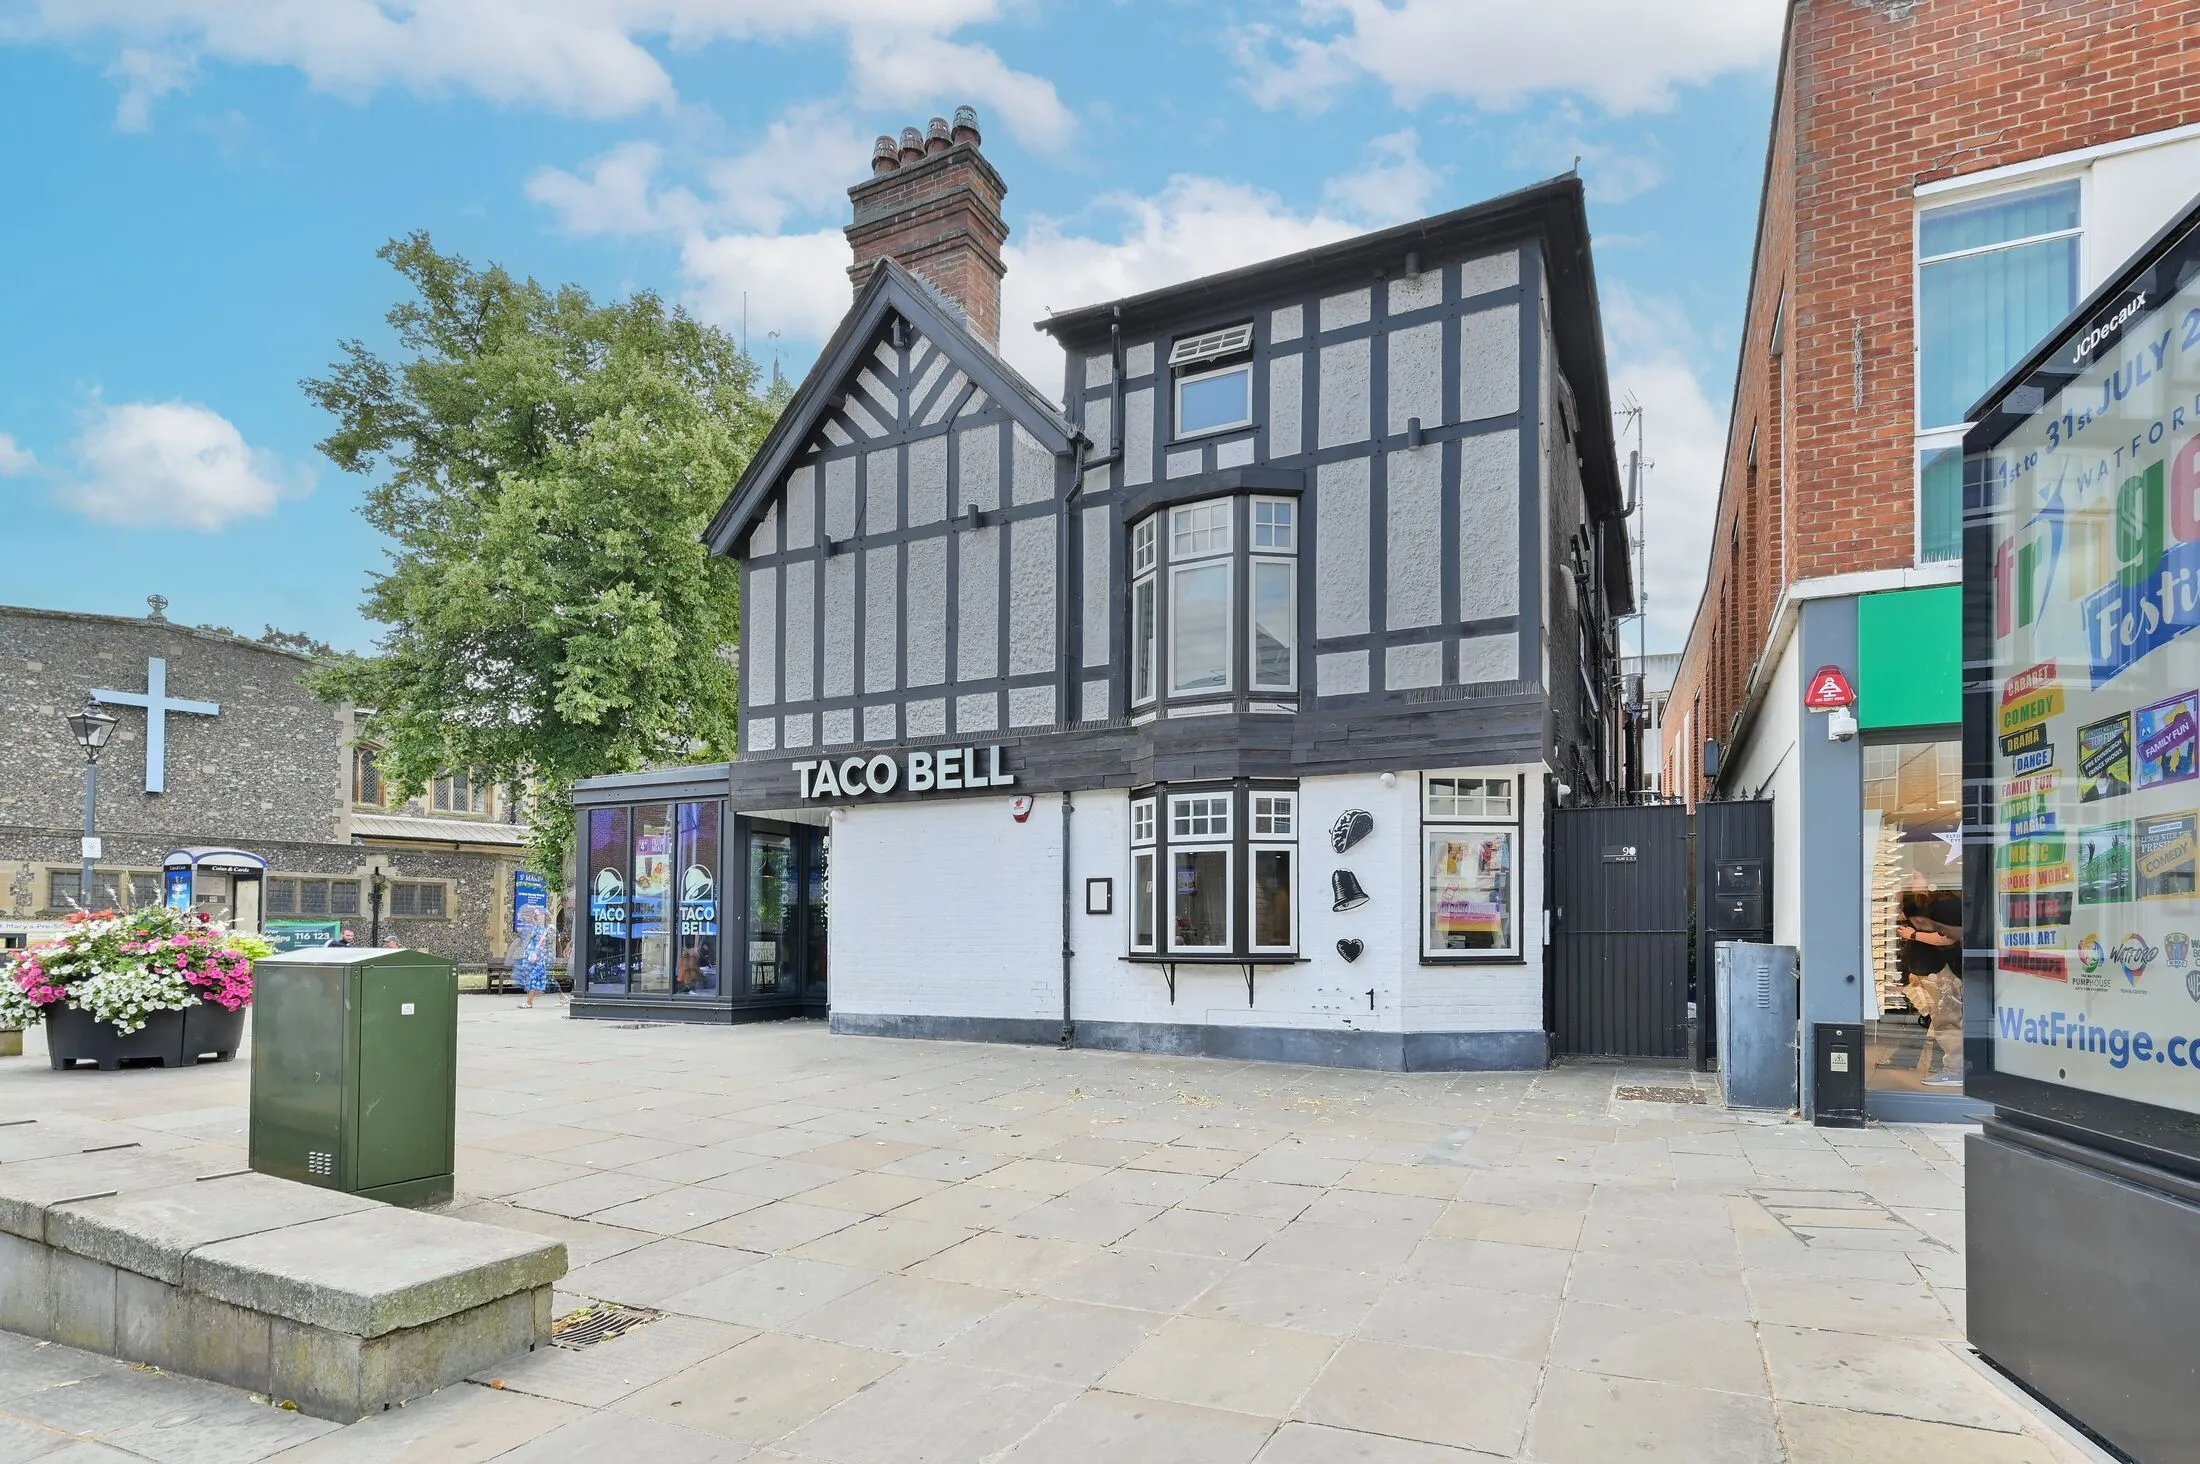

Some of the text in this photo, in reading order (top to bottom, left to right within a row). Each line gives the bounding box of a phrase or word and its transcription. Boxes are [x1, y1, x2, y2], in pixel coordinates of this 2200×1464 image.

[2072, 290, 2147, 364] JCDecaux
[2024, 451, 2038, 472] to
[2044, 407, 2093, 455] 31st
[2096, 328, 2172, 416] JULY
[2008, 665, 2049, 697] CABARET
[2004, 694, 2053, 728] COMEDY
[2007, 729, 2040, 753] DRAMA
[2145, 721, 2190, 758] FAMILY FUN
[2017, 750, 2048, 771] DANCE
[791, 744, 1015, 799] TACO BELL
[2002, 774, 2053, 798] FAMILY FUN
[2015, 815, 2046, 836] MAGIC
[1622, 846, 1636, 856] 90
[2010, 843, 2049, 864] MUSIC
[2145, 842, 2189, 873] COMEDY
[592, 907, 625, 921] TACO
[680, 906, 715, 921] TACO
[295, 932, 330, 940] 116 123
[594, 921, 624, 935] BELL
[681, 921, 714, 935] BELL
[2003, 930, 2057, 947] VISUAL ART
[2109, 943, 2160, 965] WATFORD
[2072, 978, 2112, 988] PUMPHOUSE
[1365, 988, 1374, 1011] 1
